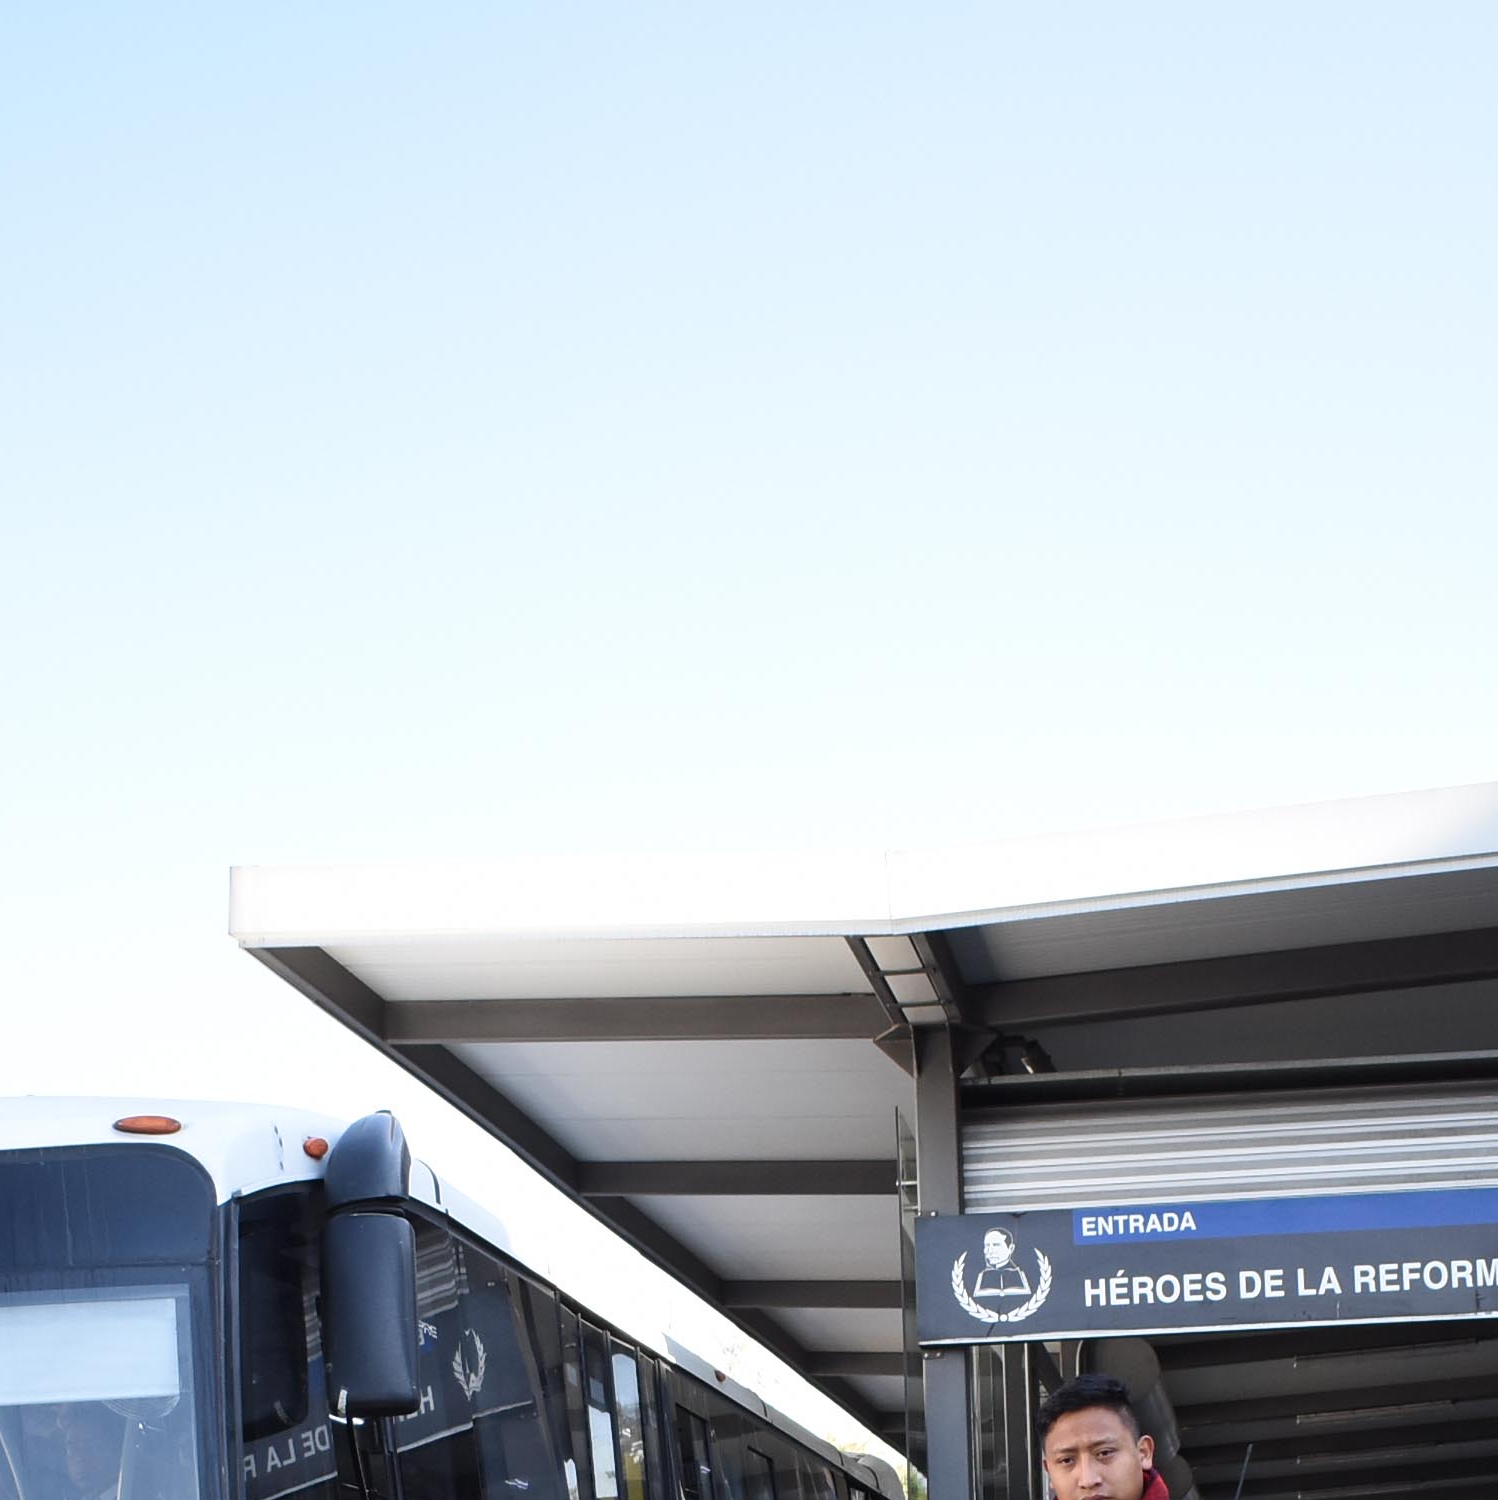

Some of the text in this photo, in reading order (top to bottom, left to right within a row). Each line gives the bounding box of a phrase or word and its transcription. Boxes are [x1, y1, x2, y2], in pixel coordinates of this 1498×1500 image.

[1080, 1210, 1198, 1238] ENTRADA
[1083, 1268, 1228, 1308] HÉROES
[1238, 1268, 1286, 1301] DE
[1296, 1264, 1342, 1298] LA
